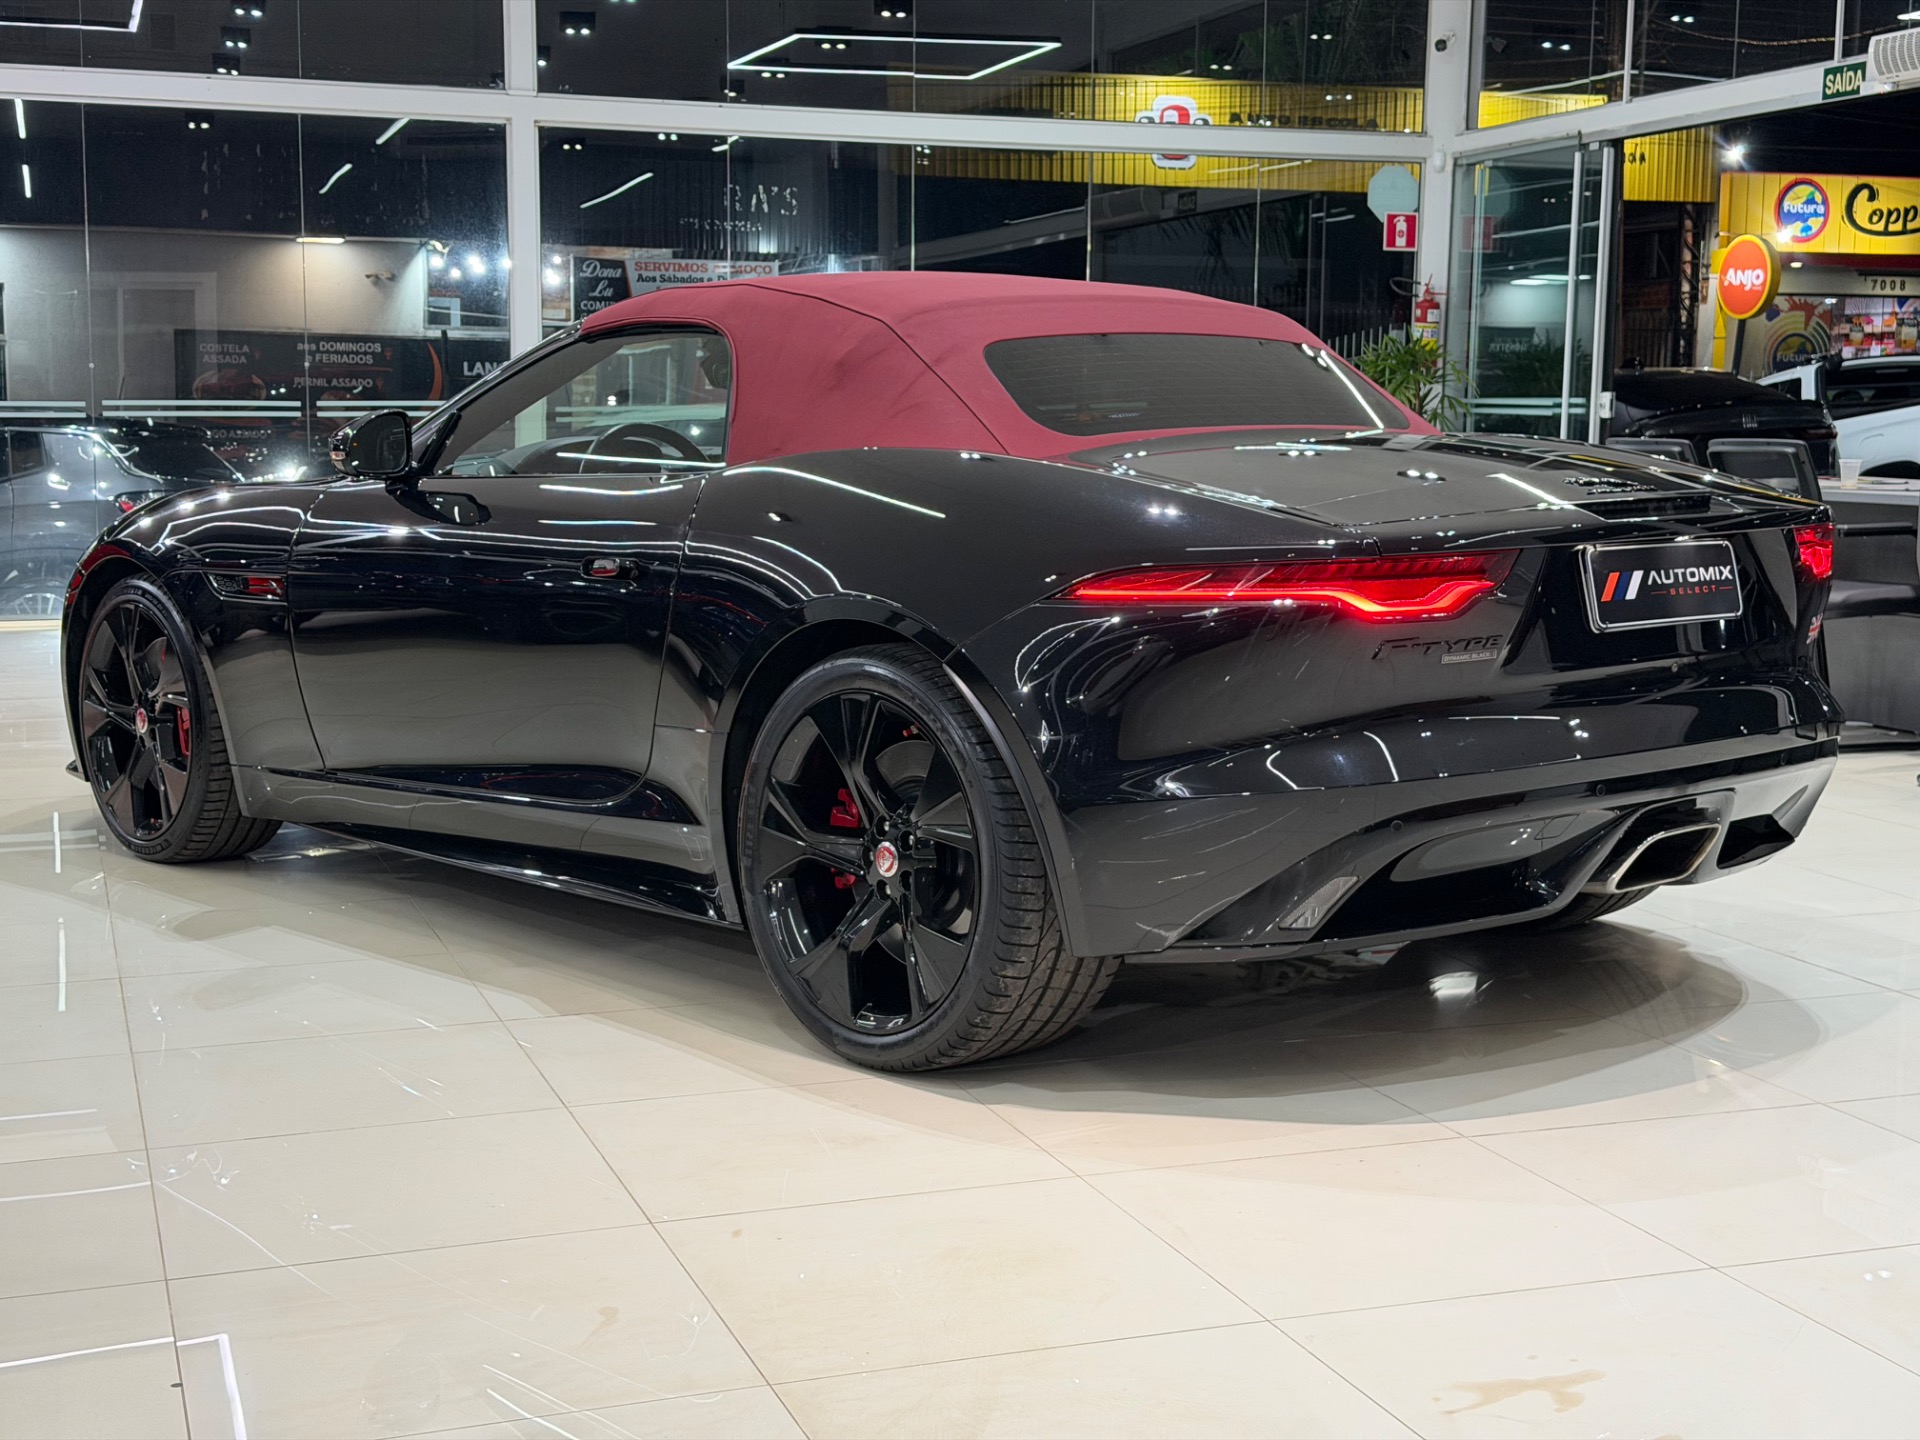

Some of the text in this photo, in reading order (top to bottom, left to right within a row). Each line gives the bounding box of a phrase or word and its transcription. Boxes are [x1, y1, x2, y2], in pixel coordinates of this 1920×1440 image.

[1825, 67, 1863, 95] SAÍDA
[1783, 202, 1826, 214] Futura
[580, 259, 622, 279] Dona
[634, 261, 708, 273] SERVIMOS
[636, 274, 657, 283] Aos
[658, 273, 705, 284] Sábados
[1724, 267, 1765, 291] ANJO
[588, 279, 614, 297] Lu
[1871, 279, 1906, 291] 7008
[200, 343, 250, 353] COSTELA
[319, 341, 382, 353] DOMINGOS
[202, 354, 248, 364] ASSADA
[315, 353, 374, 365] FERIADOS
[463, 361, 503, 376] LAN
[293, 376, 373, 388] PERNIL ASSADO
[1647, 565, 1733, 585] AUTOMIX
[1669, 585, 1717, 595] SELECT
[1371, 634, 1503, 660] F-TYPE
[1444, 651, 1491, 662] DYNAMIC BLACK
